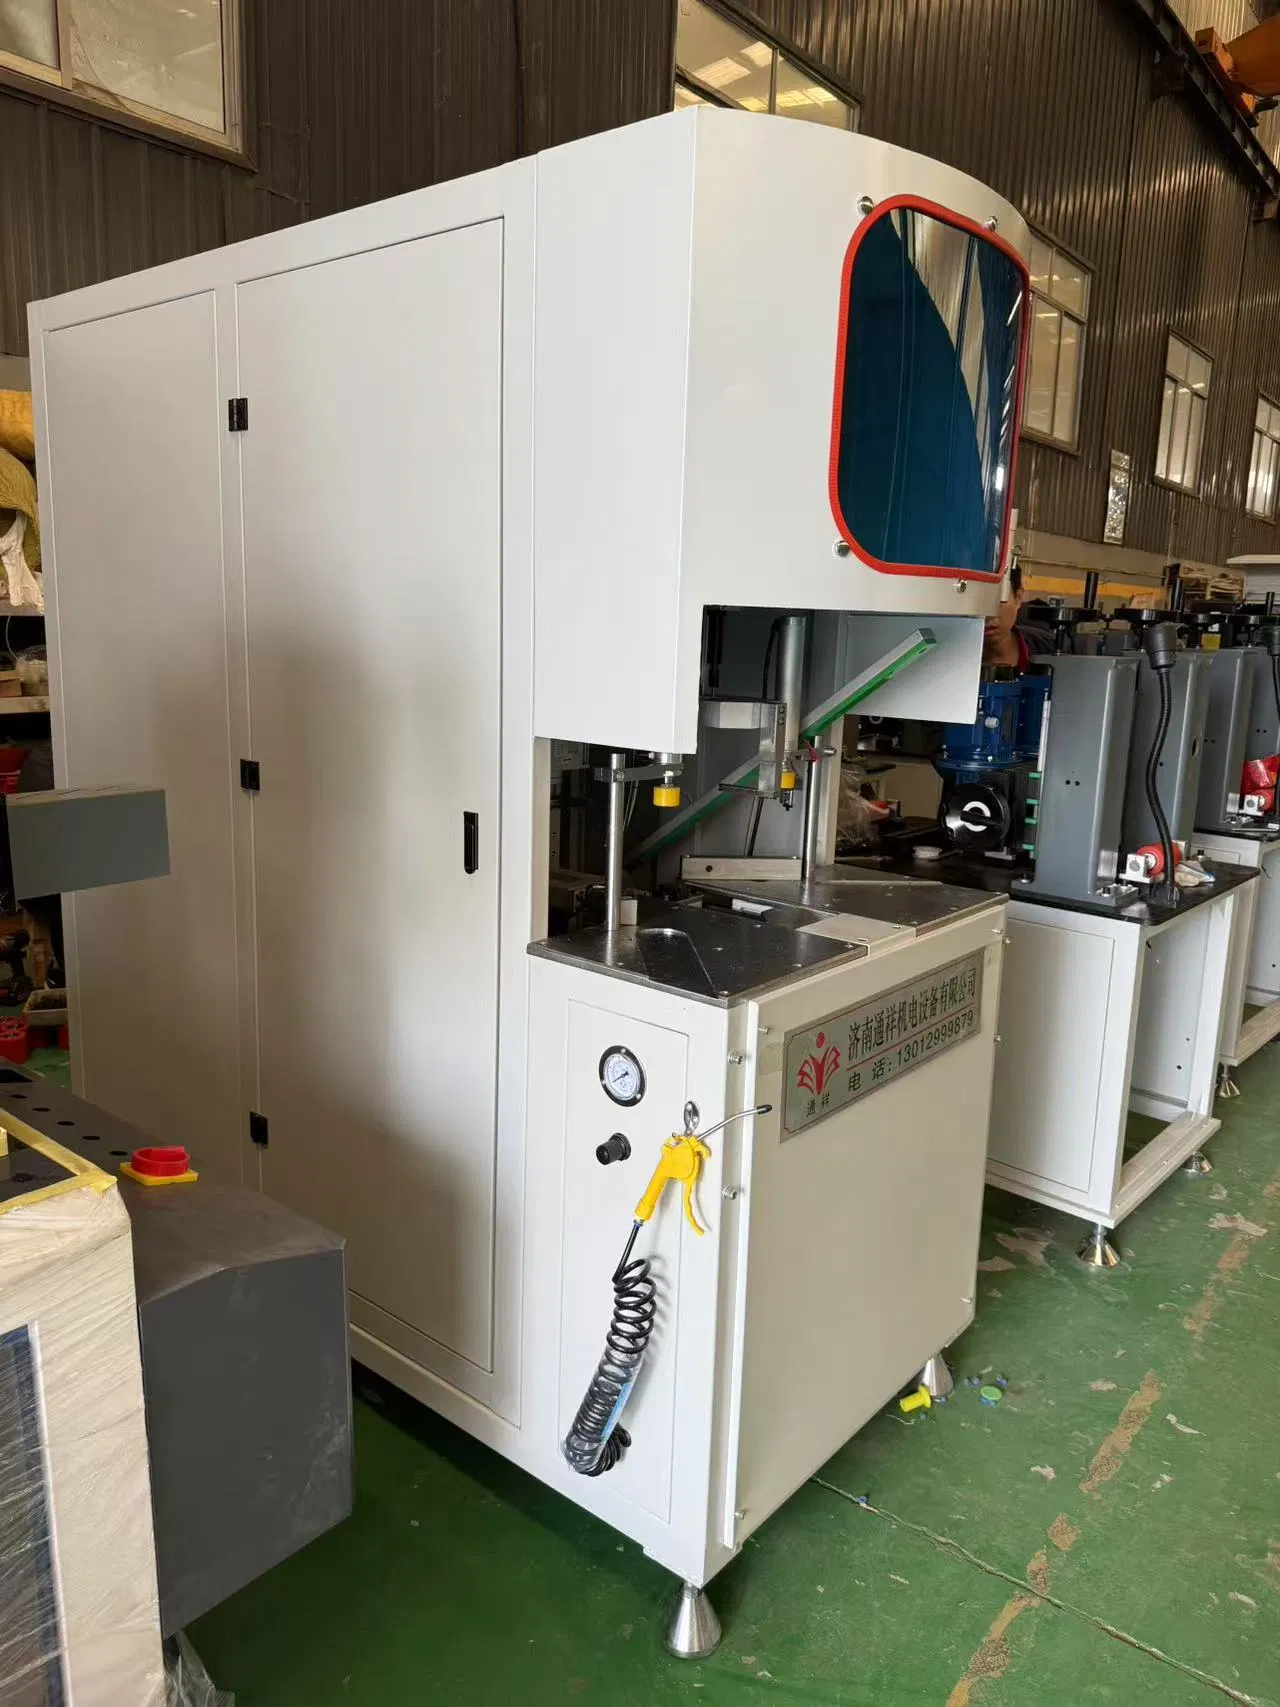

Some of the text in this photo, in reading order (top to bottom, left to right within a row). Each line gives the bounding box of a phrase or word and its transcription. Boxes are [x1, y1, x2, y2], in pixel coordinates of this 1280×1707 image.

[848, 967, 976, 1061] 济南通祥机电设备有限公司
